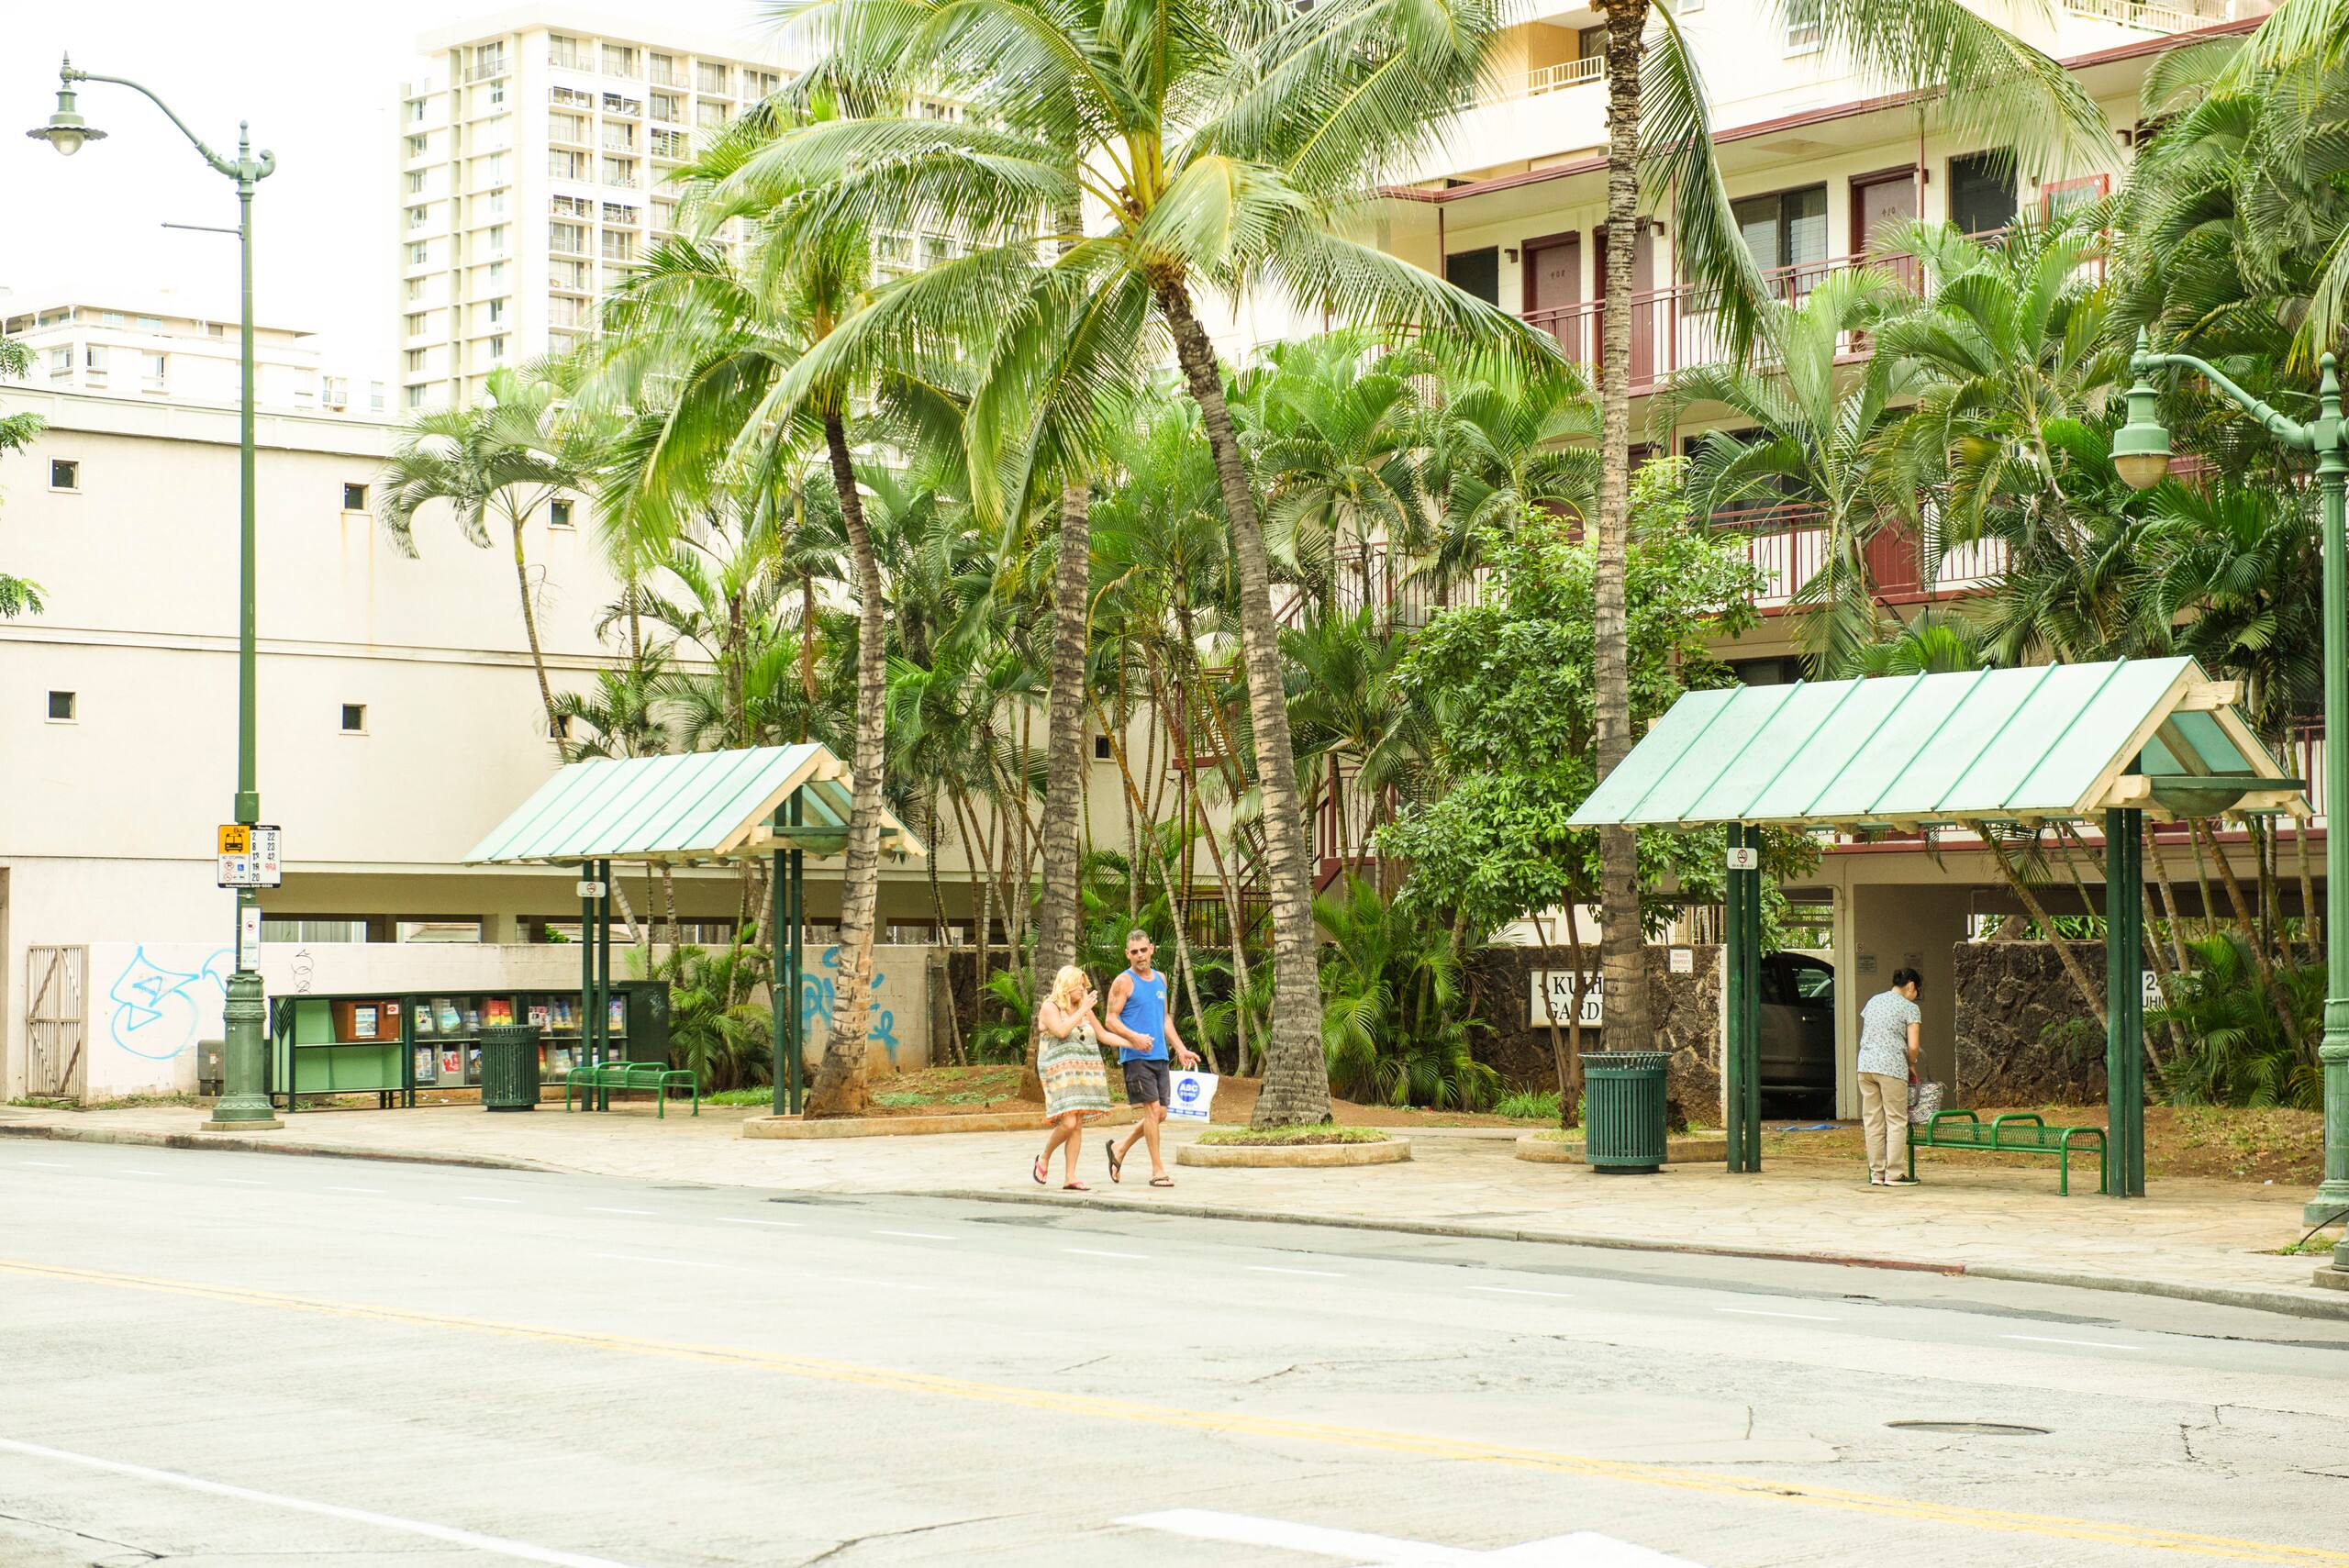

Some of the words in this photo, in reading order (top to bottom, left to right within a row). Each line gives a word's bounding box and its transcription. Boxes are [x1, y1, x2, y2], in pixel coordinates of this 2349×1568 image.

[251, 832, 257, 841] 2
[267, 832, 275, 841] 22
[251, 842, 257, 851] 8
[267, 842, 275, 851] 23
[267, 852, 275, 861] 42
[251, 873, 261, 882] 20
[1553, 976, 1604, 995] KUHI
[2145, 973, 2159, 991] 2
[1546, 1001, 1604, 1020] GARD
[1180, 1084, 1198, 1092] ABC
